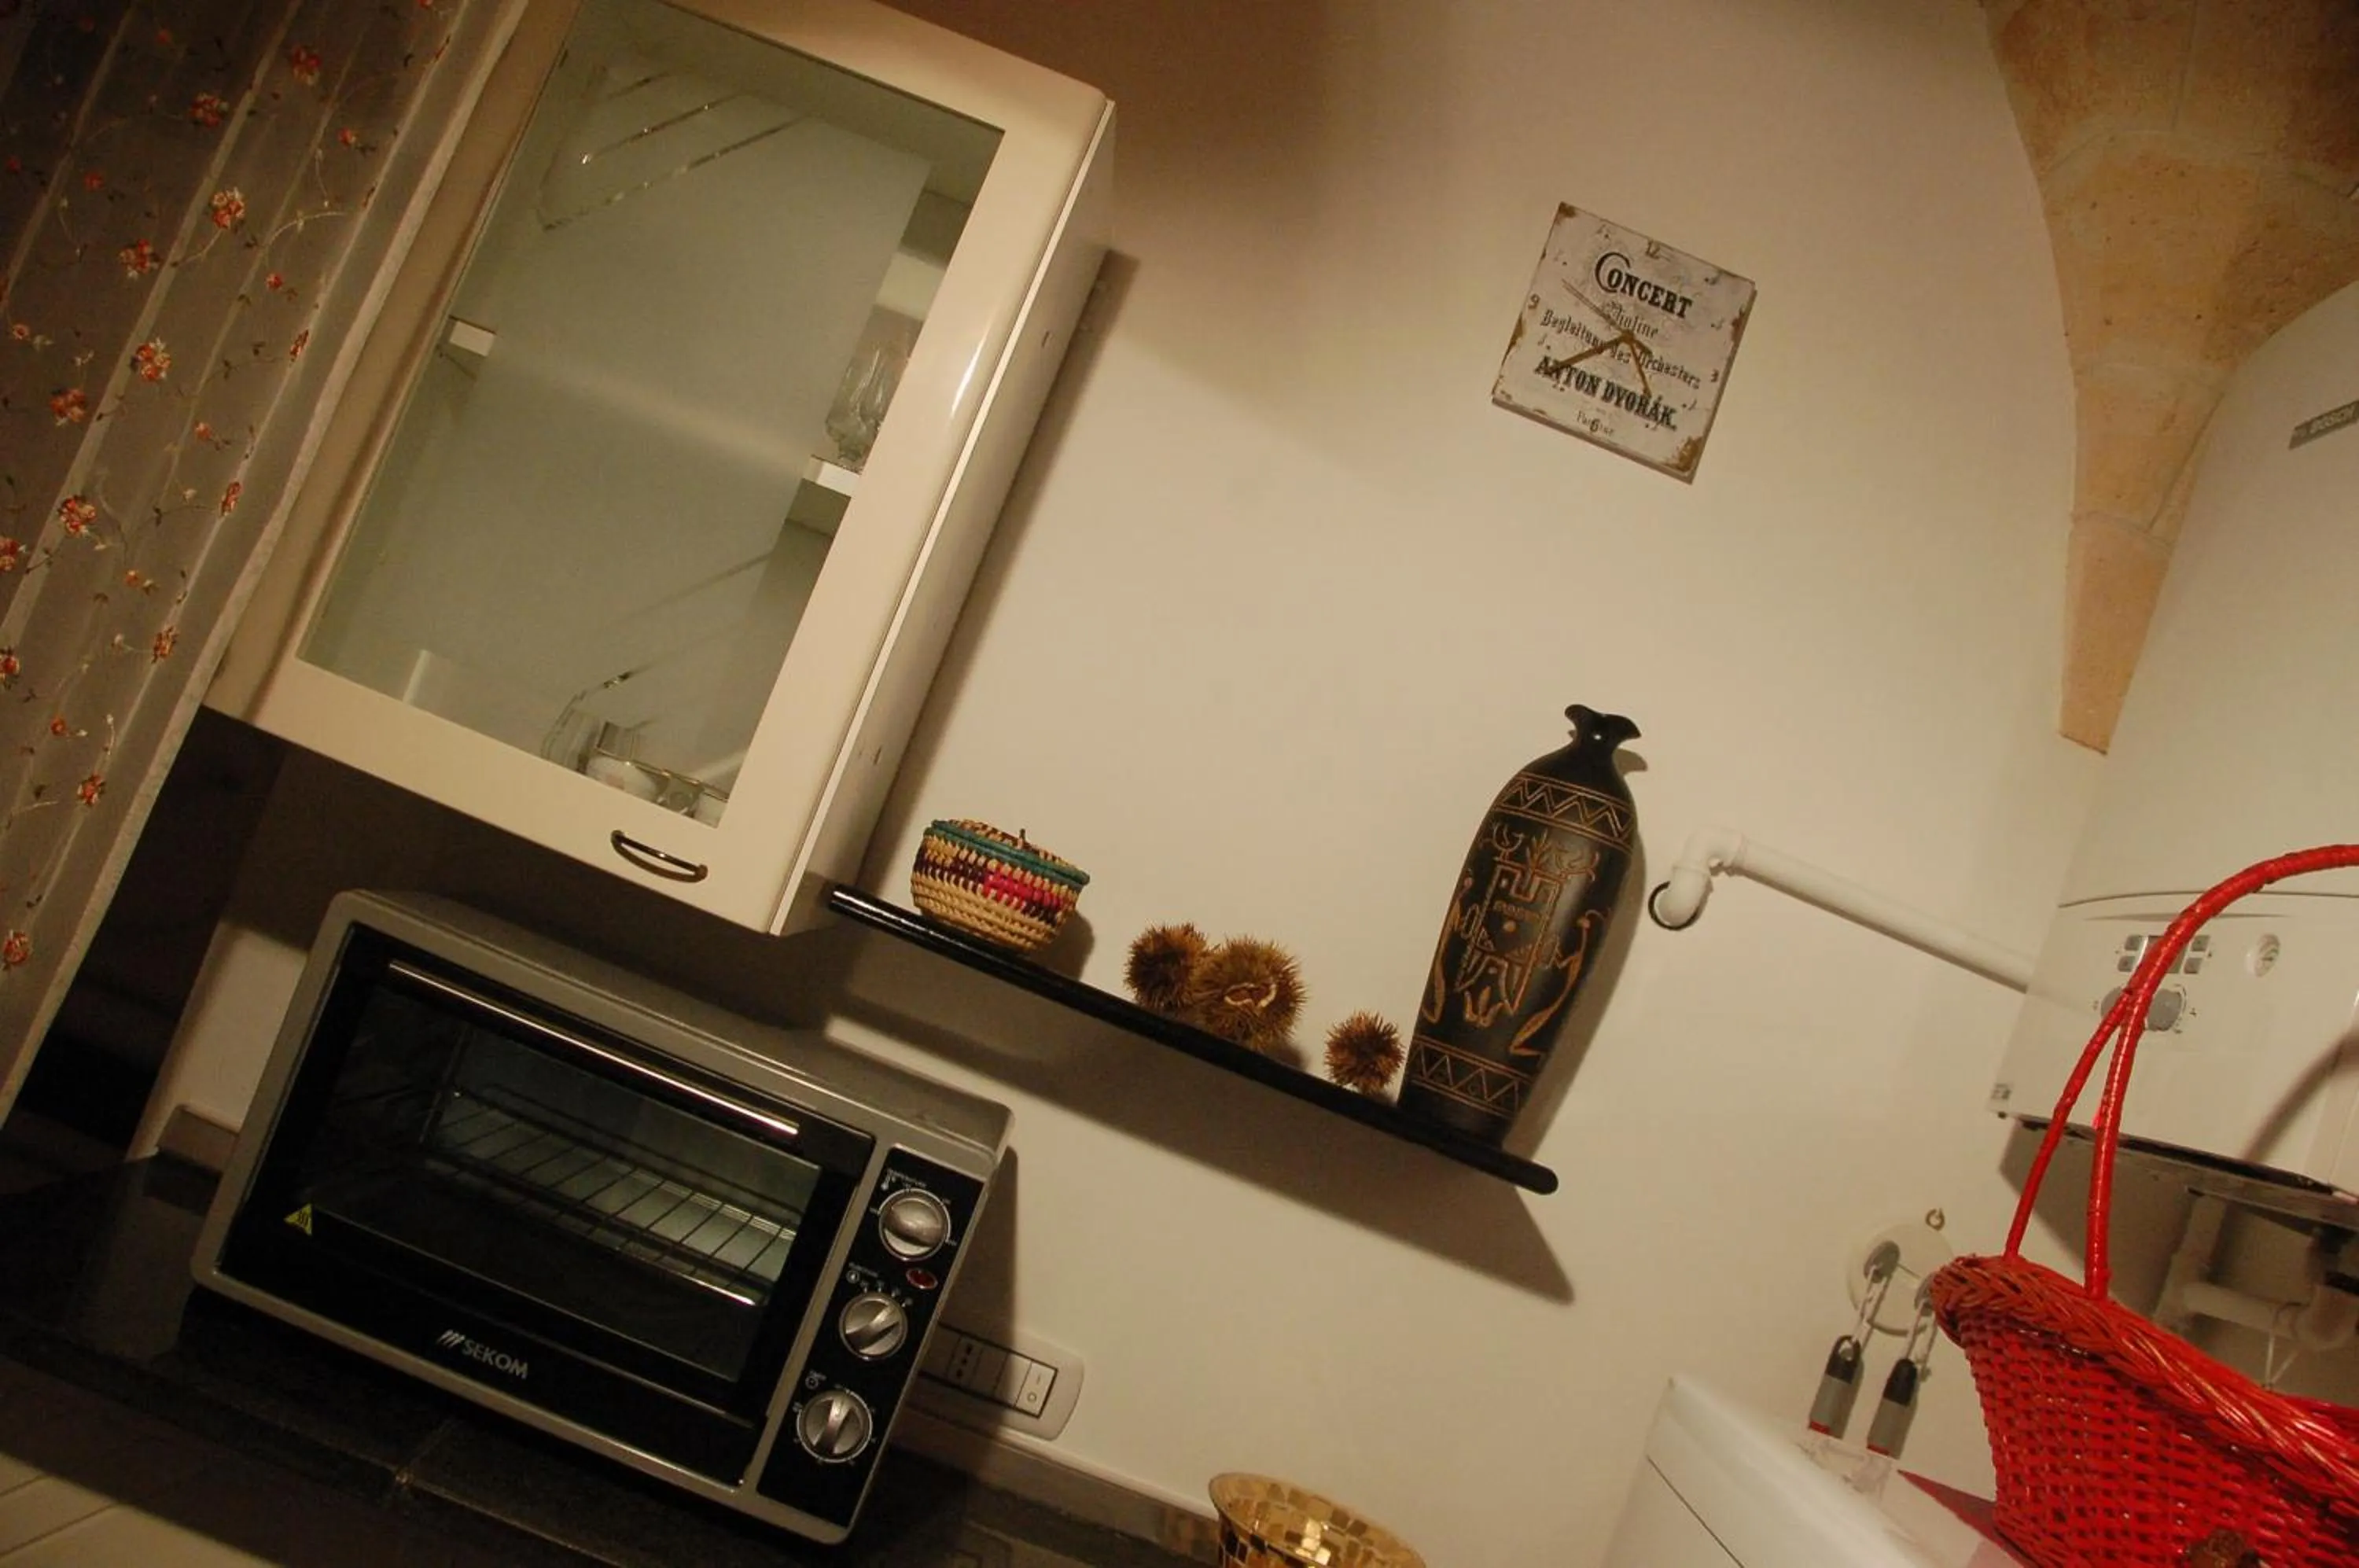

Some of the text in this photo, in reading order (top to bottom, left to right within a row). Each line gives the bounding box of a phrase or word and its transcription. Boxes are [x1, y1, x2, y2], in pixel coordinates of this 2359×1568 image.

[1594, 250, 1694, 319] CONCERT
[1527, 293, 1541, 311] 9
[1709, 369, 1720, 384] 3
[462, 1338, 529, 1380] SEKOM
